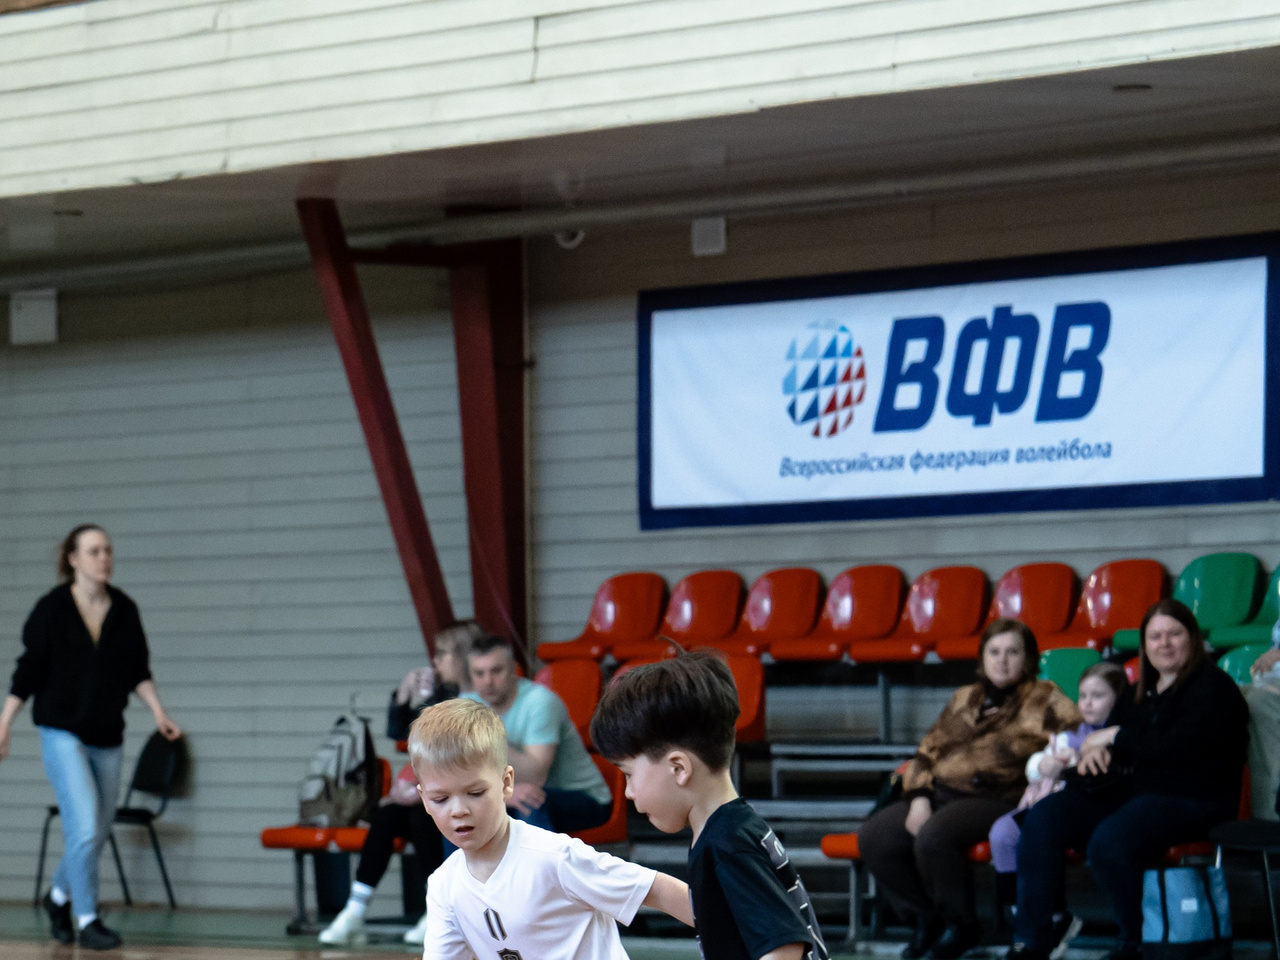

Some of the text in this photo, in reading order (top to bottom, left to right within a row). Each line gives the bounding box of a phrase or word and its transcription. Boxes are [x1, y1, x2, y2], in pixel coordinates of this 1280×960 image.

[873, 302, 1111, 434] ВФВ
[779, 438, 1113, 479] Всероссийская федерация волейбола
